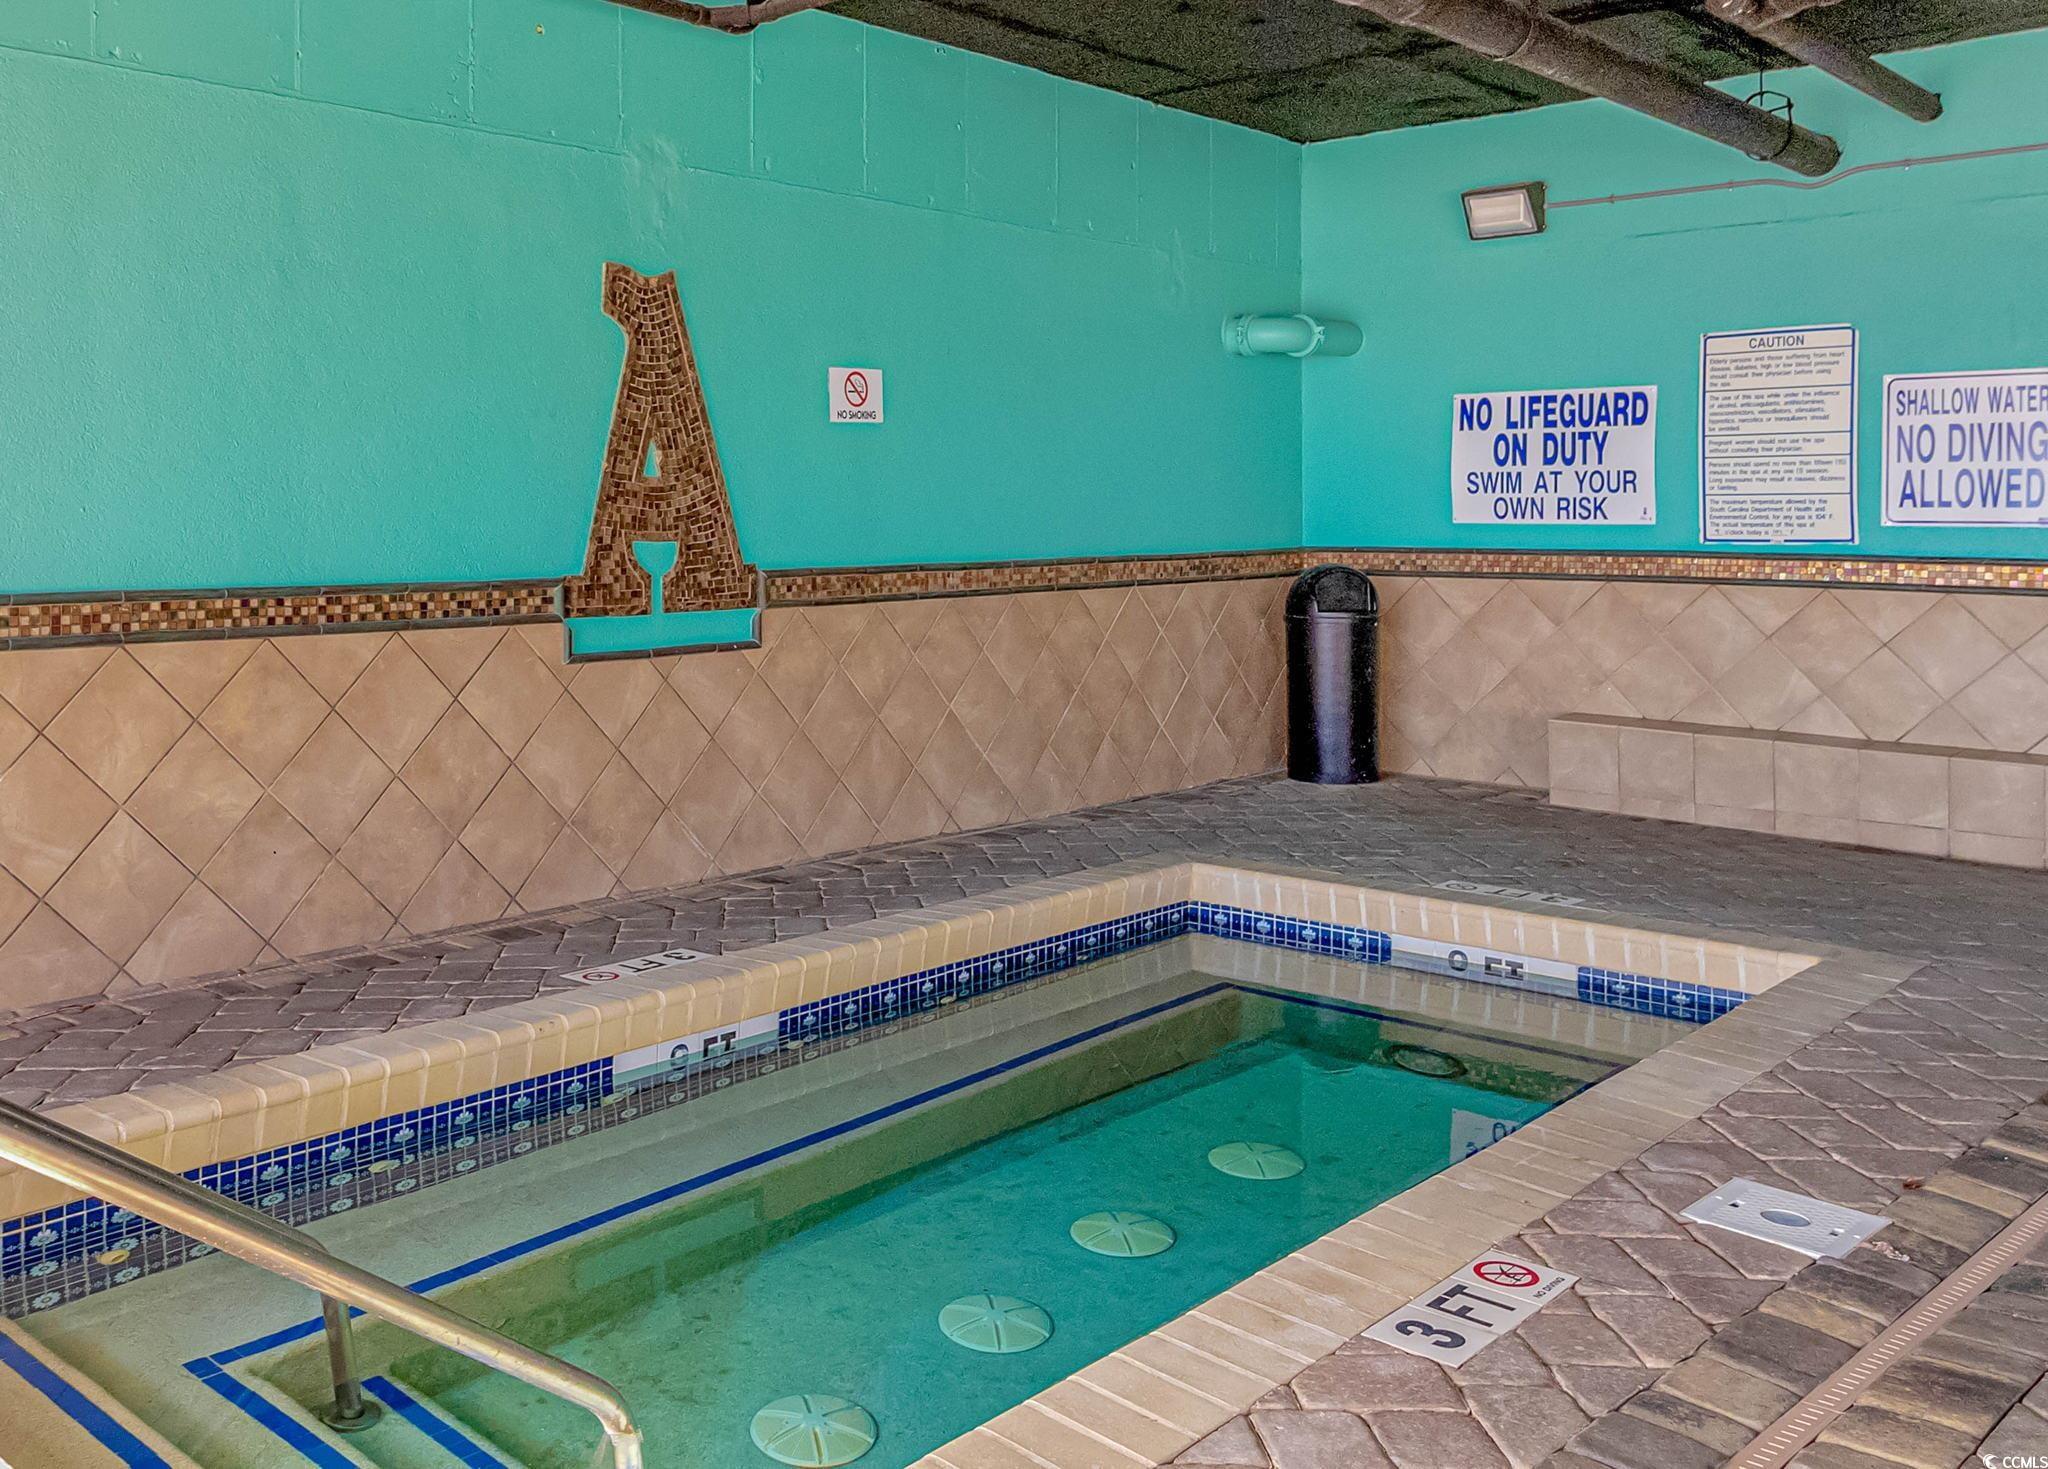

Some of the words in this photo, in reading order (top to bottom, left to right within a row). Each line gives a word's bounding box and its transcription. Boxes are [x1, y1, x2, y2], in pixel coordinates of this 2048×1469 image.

[1749, 335, 1805, 349] CAUTION
[1459, 398, 1493, 431] NO
[1505, 391, 1649, 430] LIFEGUARD
[1896, 388, 1980, 416] SHALLOW
[1987, 384, 2048, 413] WATER
[837, 410, 847, 419] NO
[848, 410, 877, 420] SMOKING
[1493, 432, 1528, 467] ON
[1542, 430, 1609, 466] DUTY
[1896, 423, 1936, 463] NO
[1948, 420, 2048, 462] DIVING
[1466, 471, 1522, 495] SWIM
[1534, 471, 1563, 494] AT
[1575, 470, 1638, 494] YOUR
[1898, 468, 2045, 509] ALLOWED
[1493, 496, 1544, 520] OWN
[1557, 496, 1609, 520] RISK
[618, 958, 668, 973] FT
[663, 952, 697, 962] 3
[1532, 1290, 1546, 1299] NO
[1542, 1276, 1566, 1292] DIVING
[1425, 1283, 1517, 1328] FT
[1395, 1319, 1466, 1349] 3
